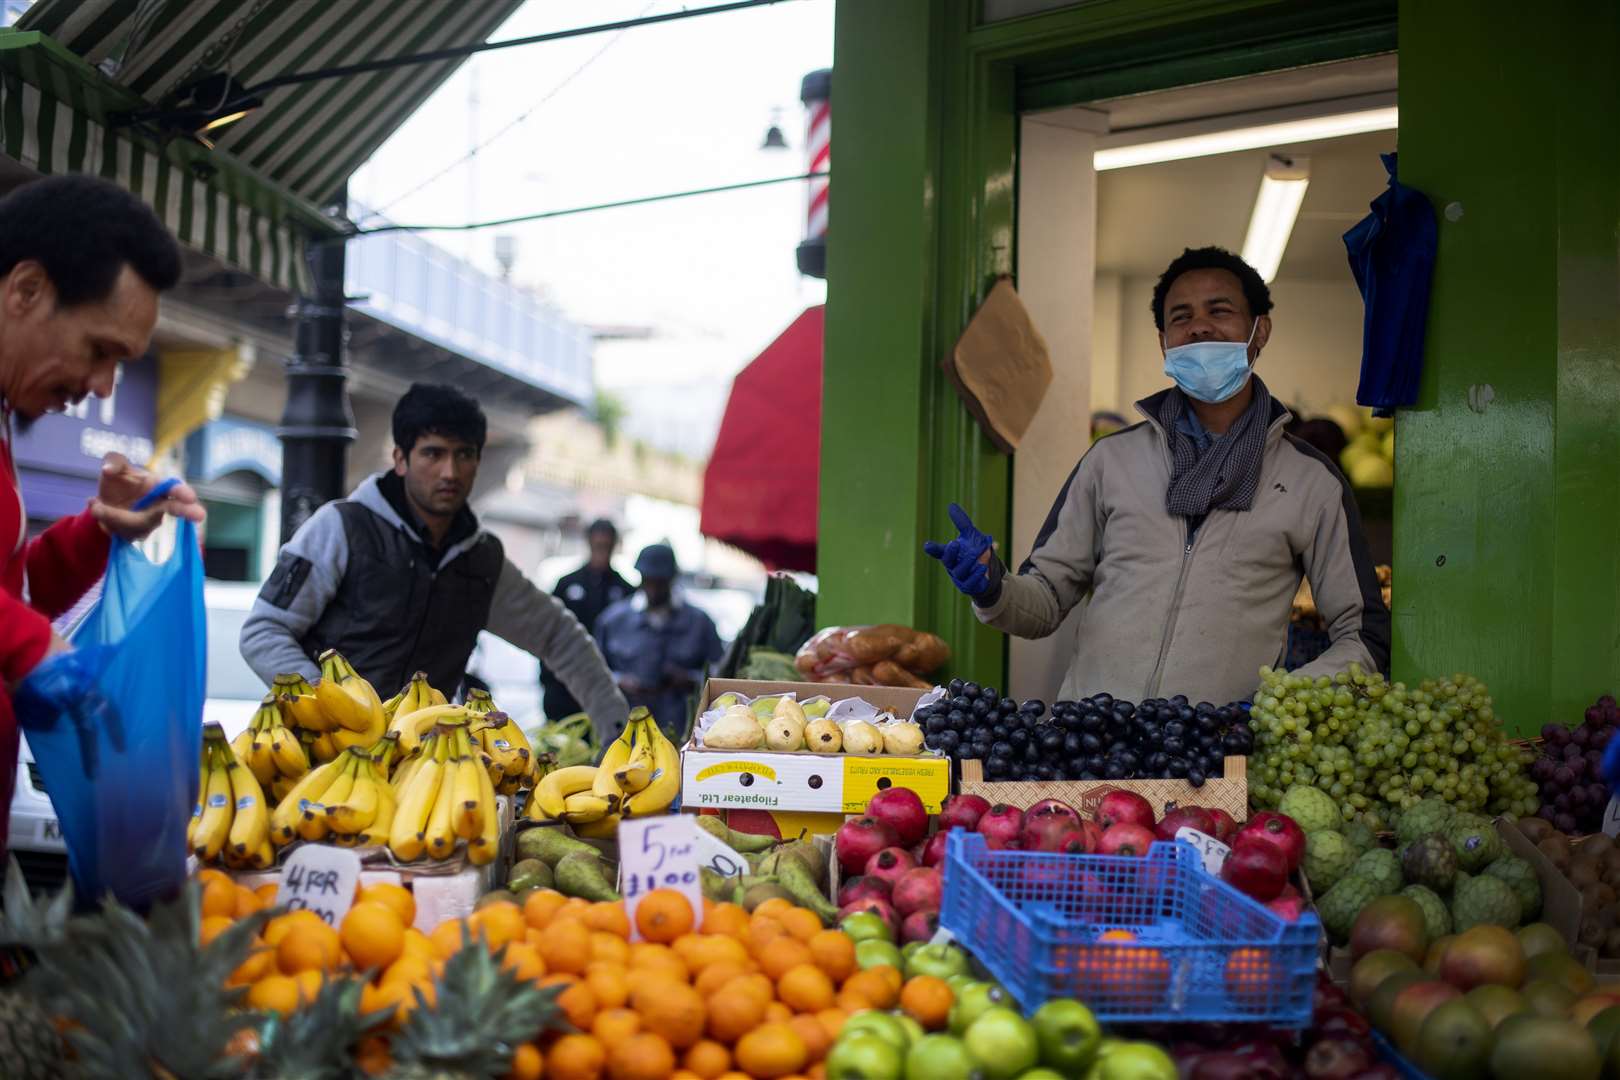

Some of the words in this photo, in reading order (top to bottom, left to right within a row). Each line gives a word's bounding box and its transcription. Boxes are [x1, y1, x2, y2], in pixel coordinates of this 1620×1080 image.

[698, 793, 720, 804] Ltd.
[722, 793, 778, 806] Filopatear
[642, 823, 666, 871] 5
[286, 863, 305, 895] 4
[304, 869, 340, 896] FOR
